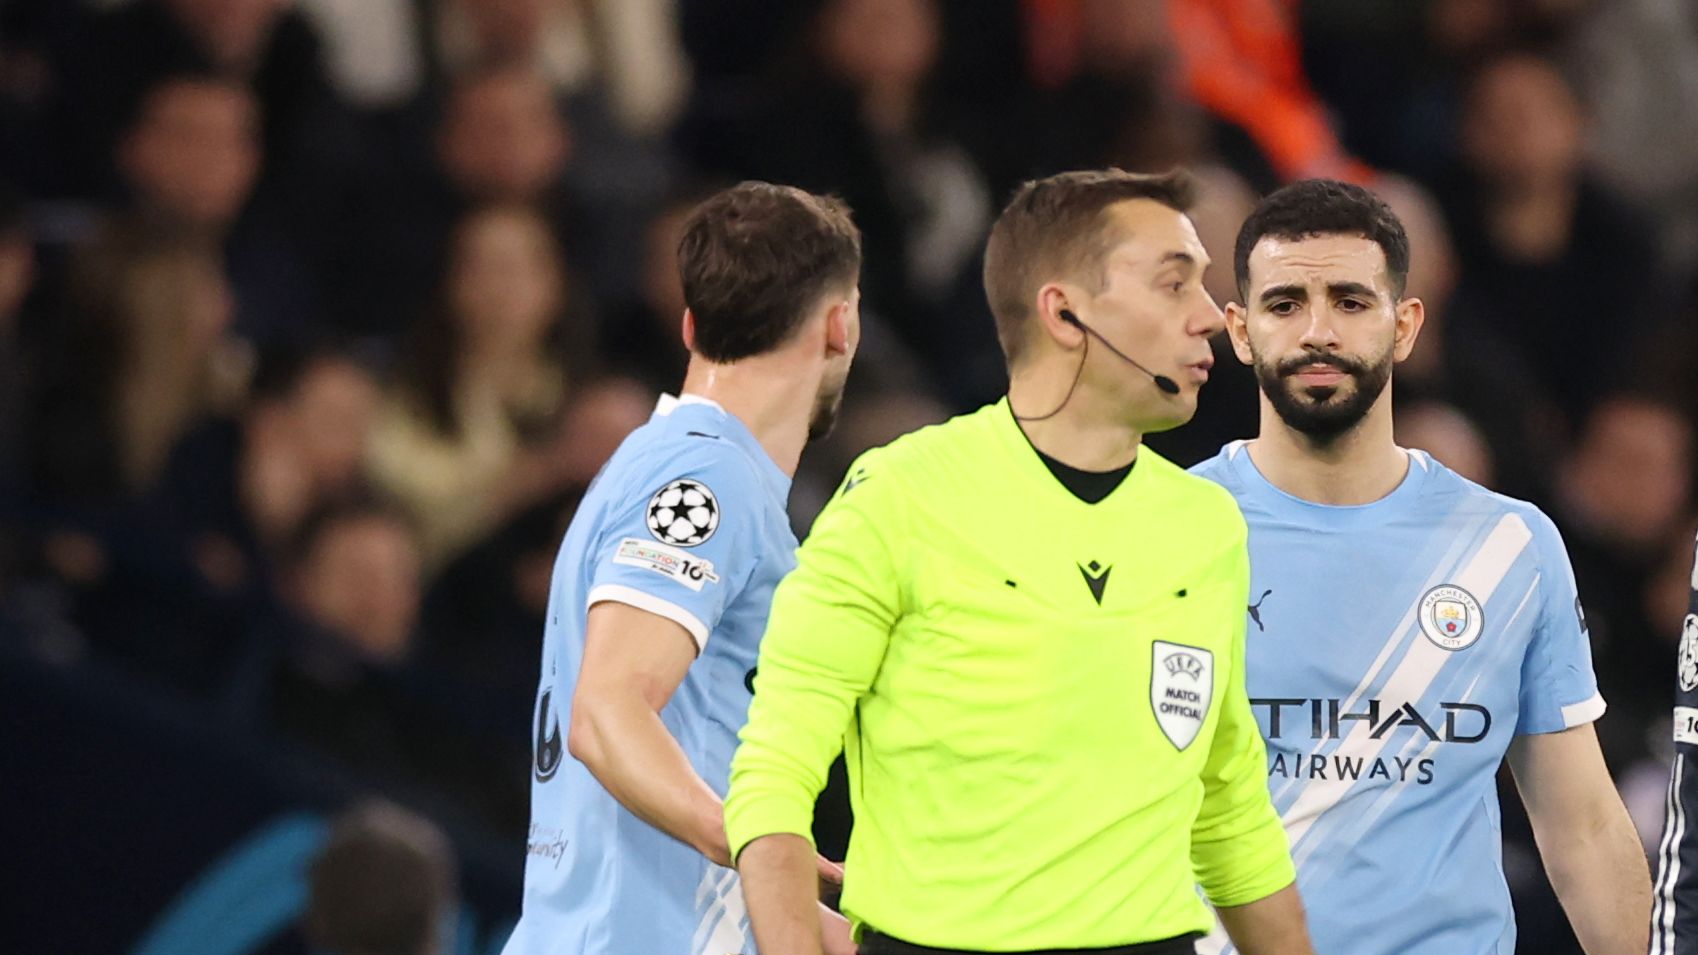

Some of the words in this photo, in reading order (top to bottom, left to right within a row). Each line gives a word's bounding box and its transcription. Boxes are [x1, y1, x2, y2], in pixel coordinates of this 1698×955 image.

[1425, 589, 1476, 611] MANCHESTER
[1163, 653, 1204, 681] UEFA
[1165, 687, 1200, 702] MATCH
[1249, 698, 1492, 744] TIHAD
[1268, 753, 1435, 785] AIRWAYS
